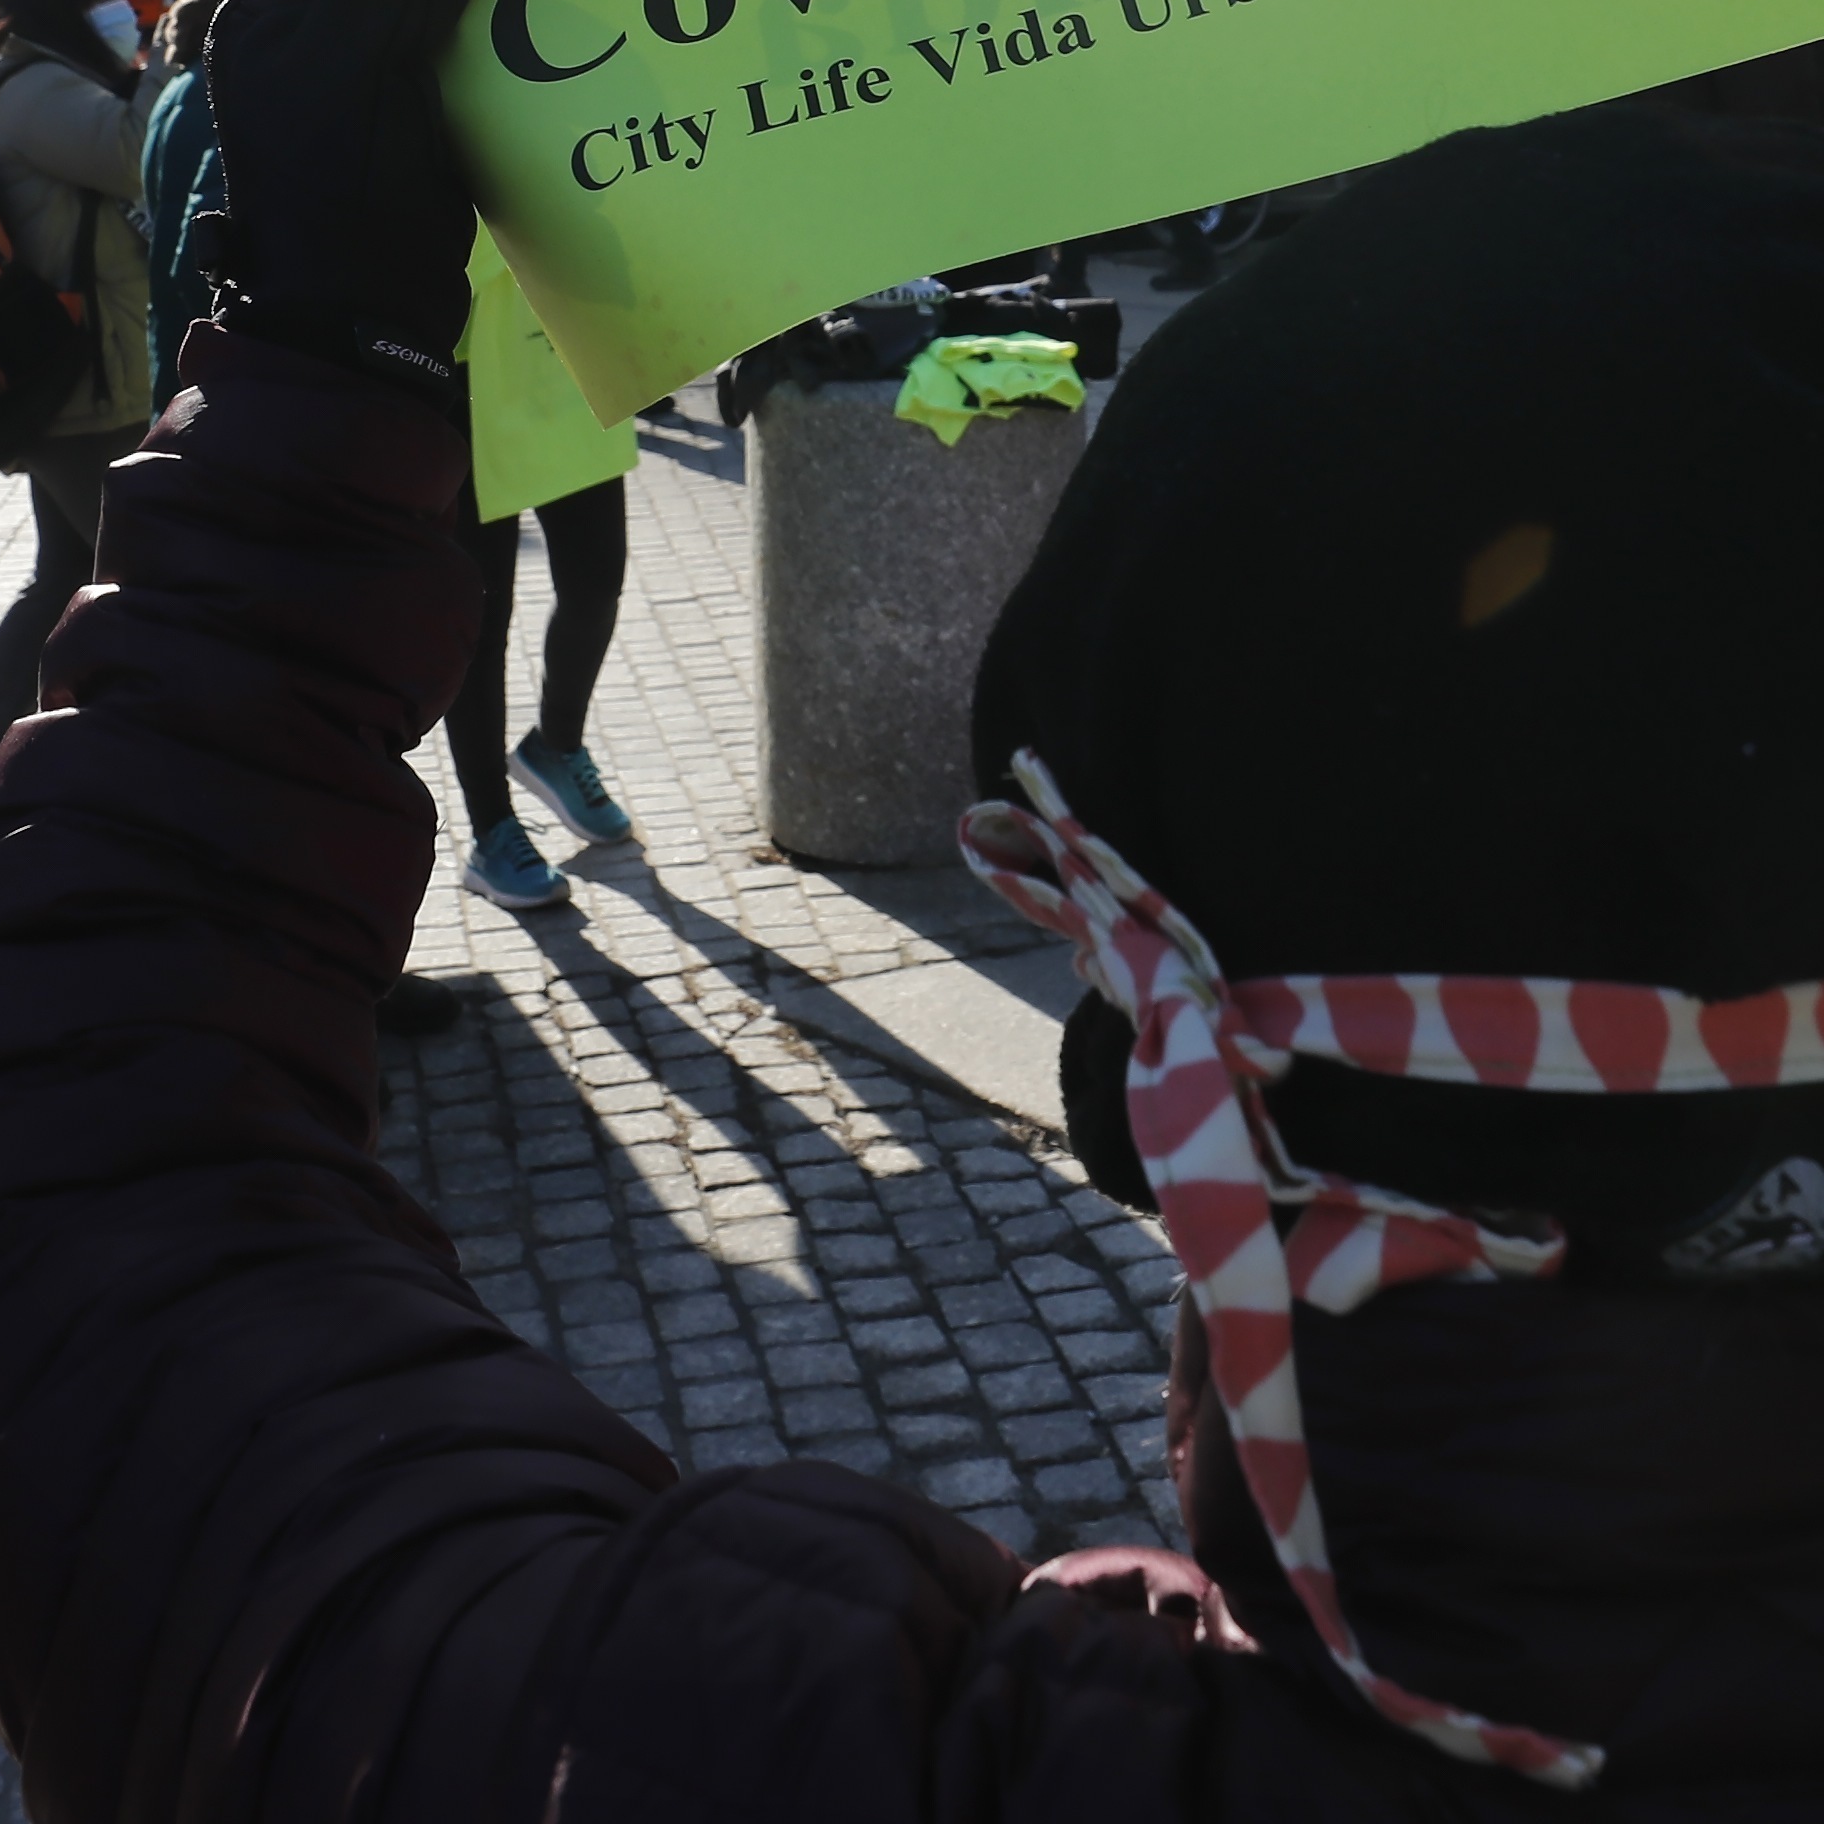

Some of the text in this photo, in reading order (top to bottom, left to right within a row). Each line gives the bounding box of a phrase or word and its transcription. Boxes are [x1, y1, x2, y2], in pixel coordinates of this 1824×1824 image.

[571, 109, 716, 191] City
[737, 58, 892, 135] Life
[909, 9, 1096, 85] Vida
